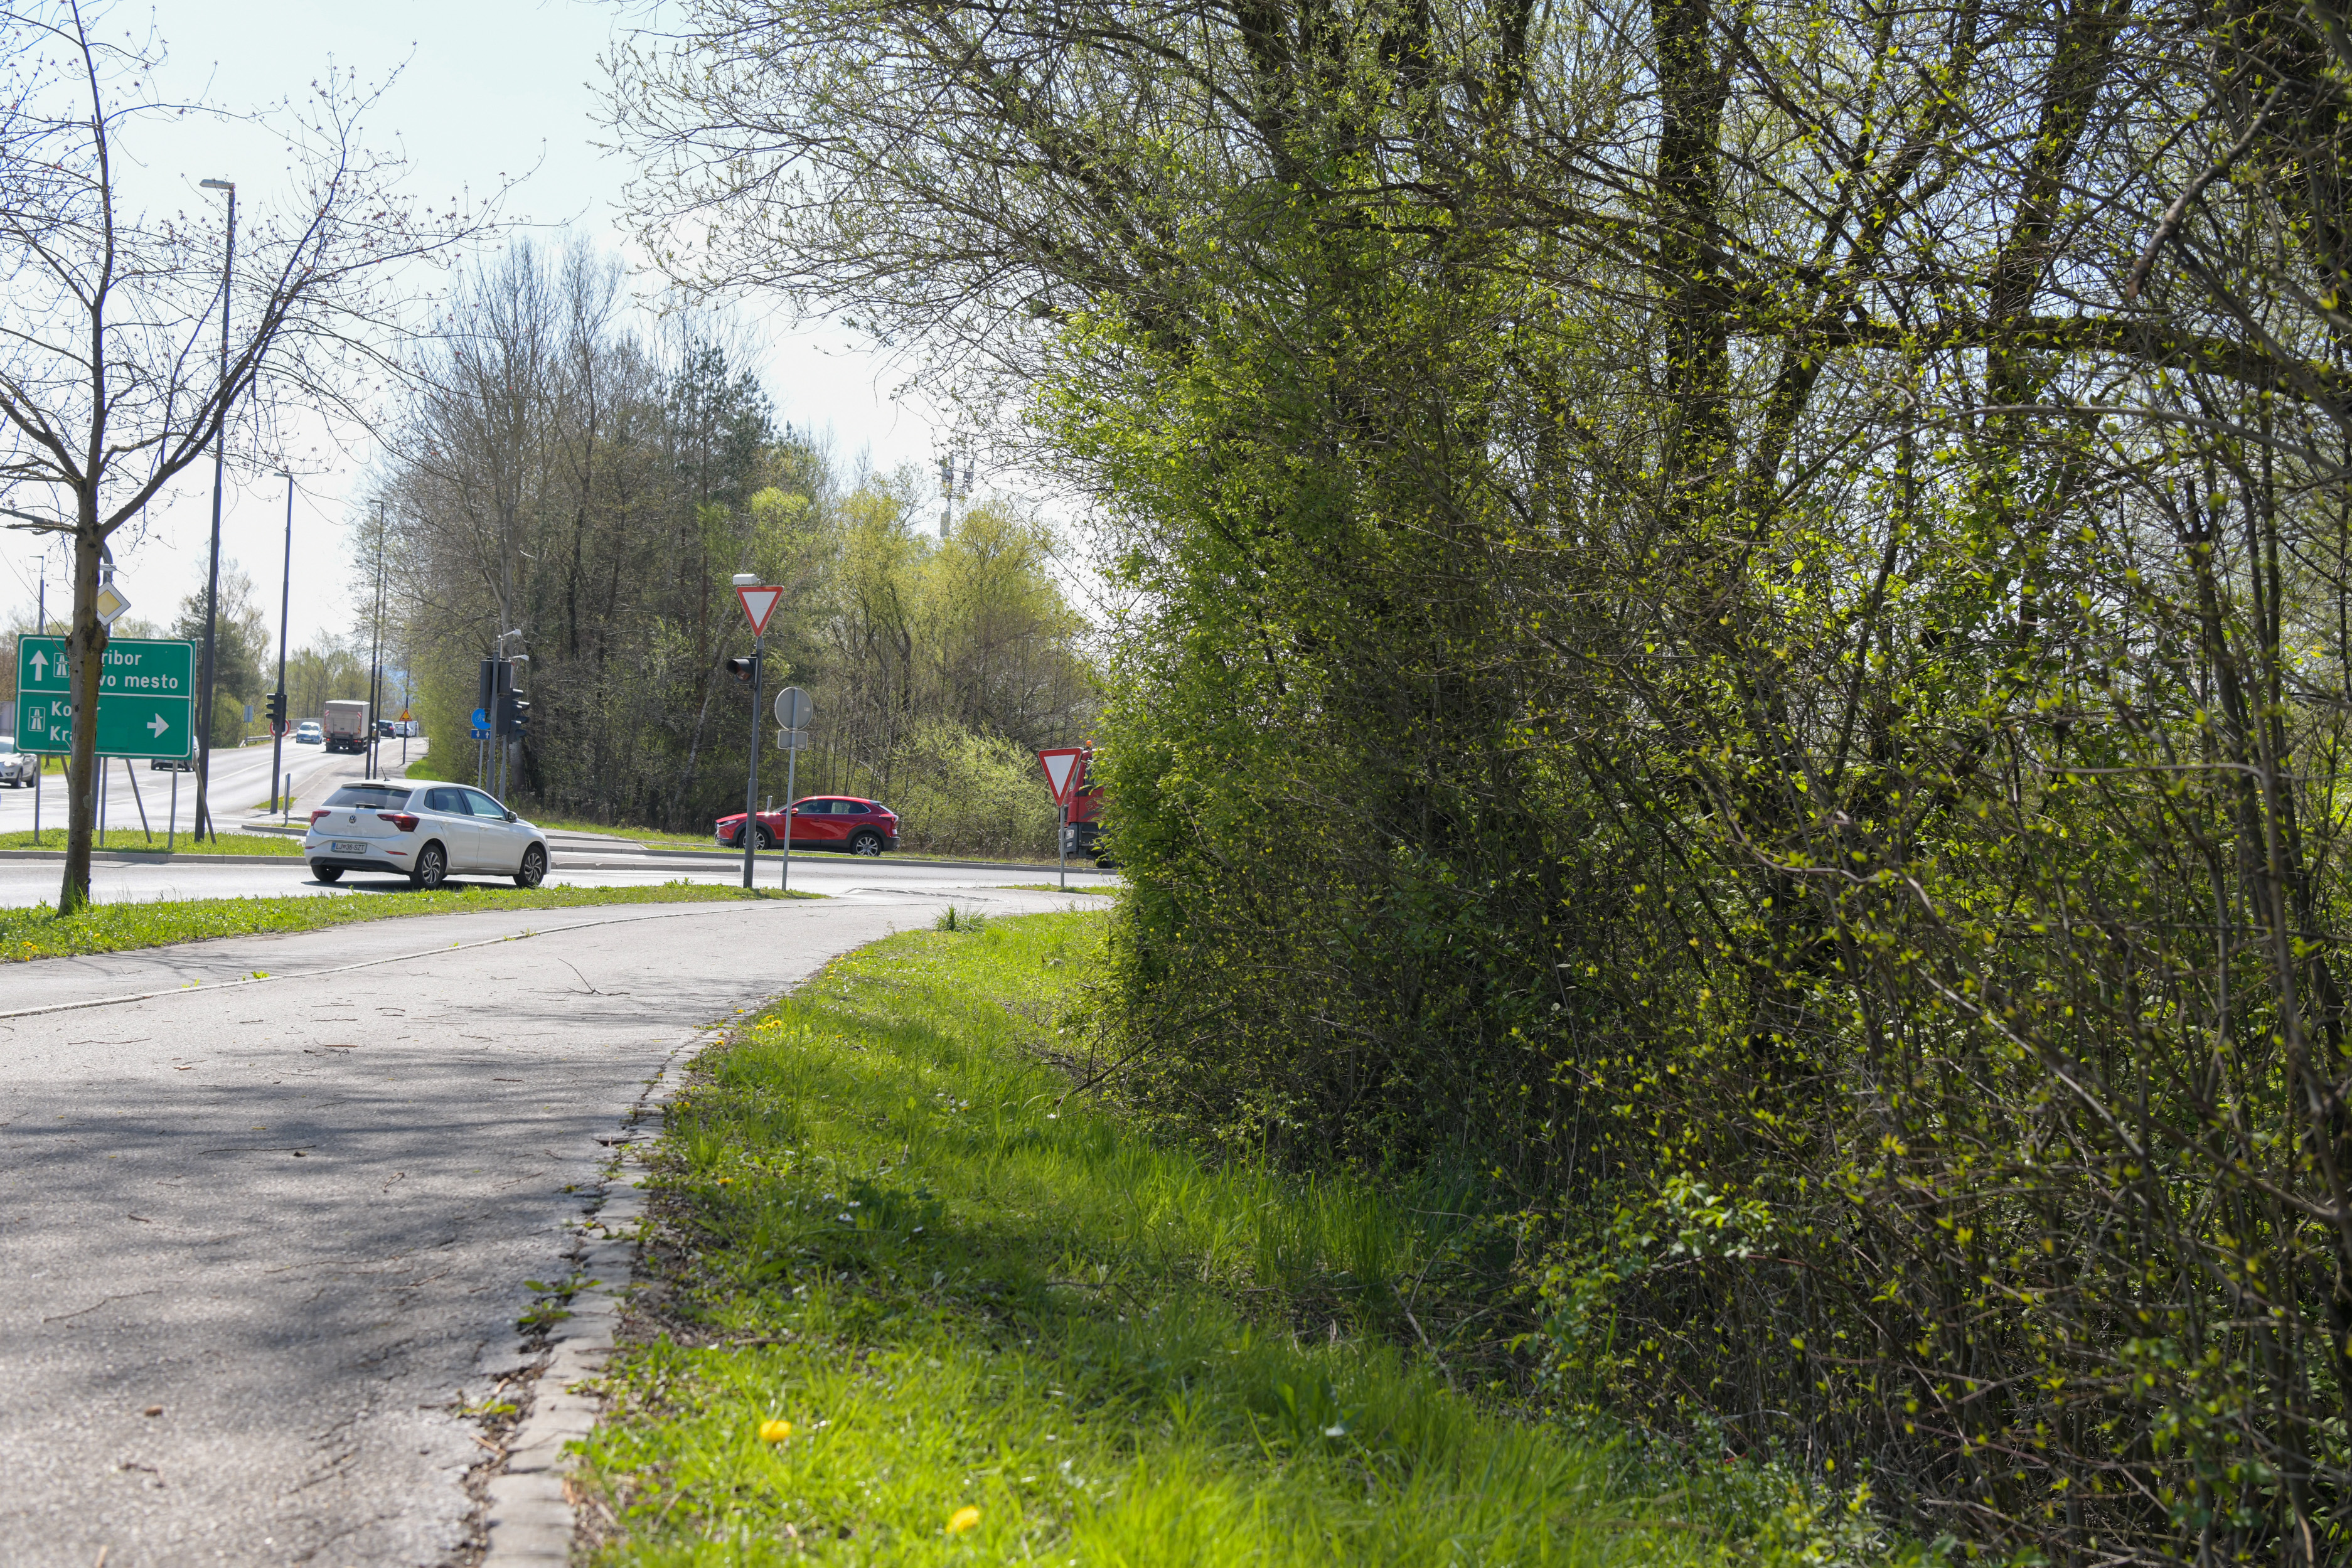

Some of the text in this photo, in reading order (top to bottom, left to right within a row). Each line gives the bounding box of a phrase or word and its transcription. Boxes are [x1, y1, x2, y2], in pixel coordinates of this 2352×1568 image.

[101, 649, 142, 666] ribor
[99, 673, 178, 689] vo mesto
